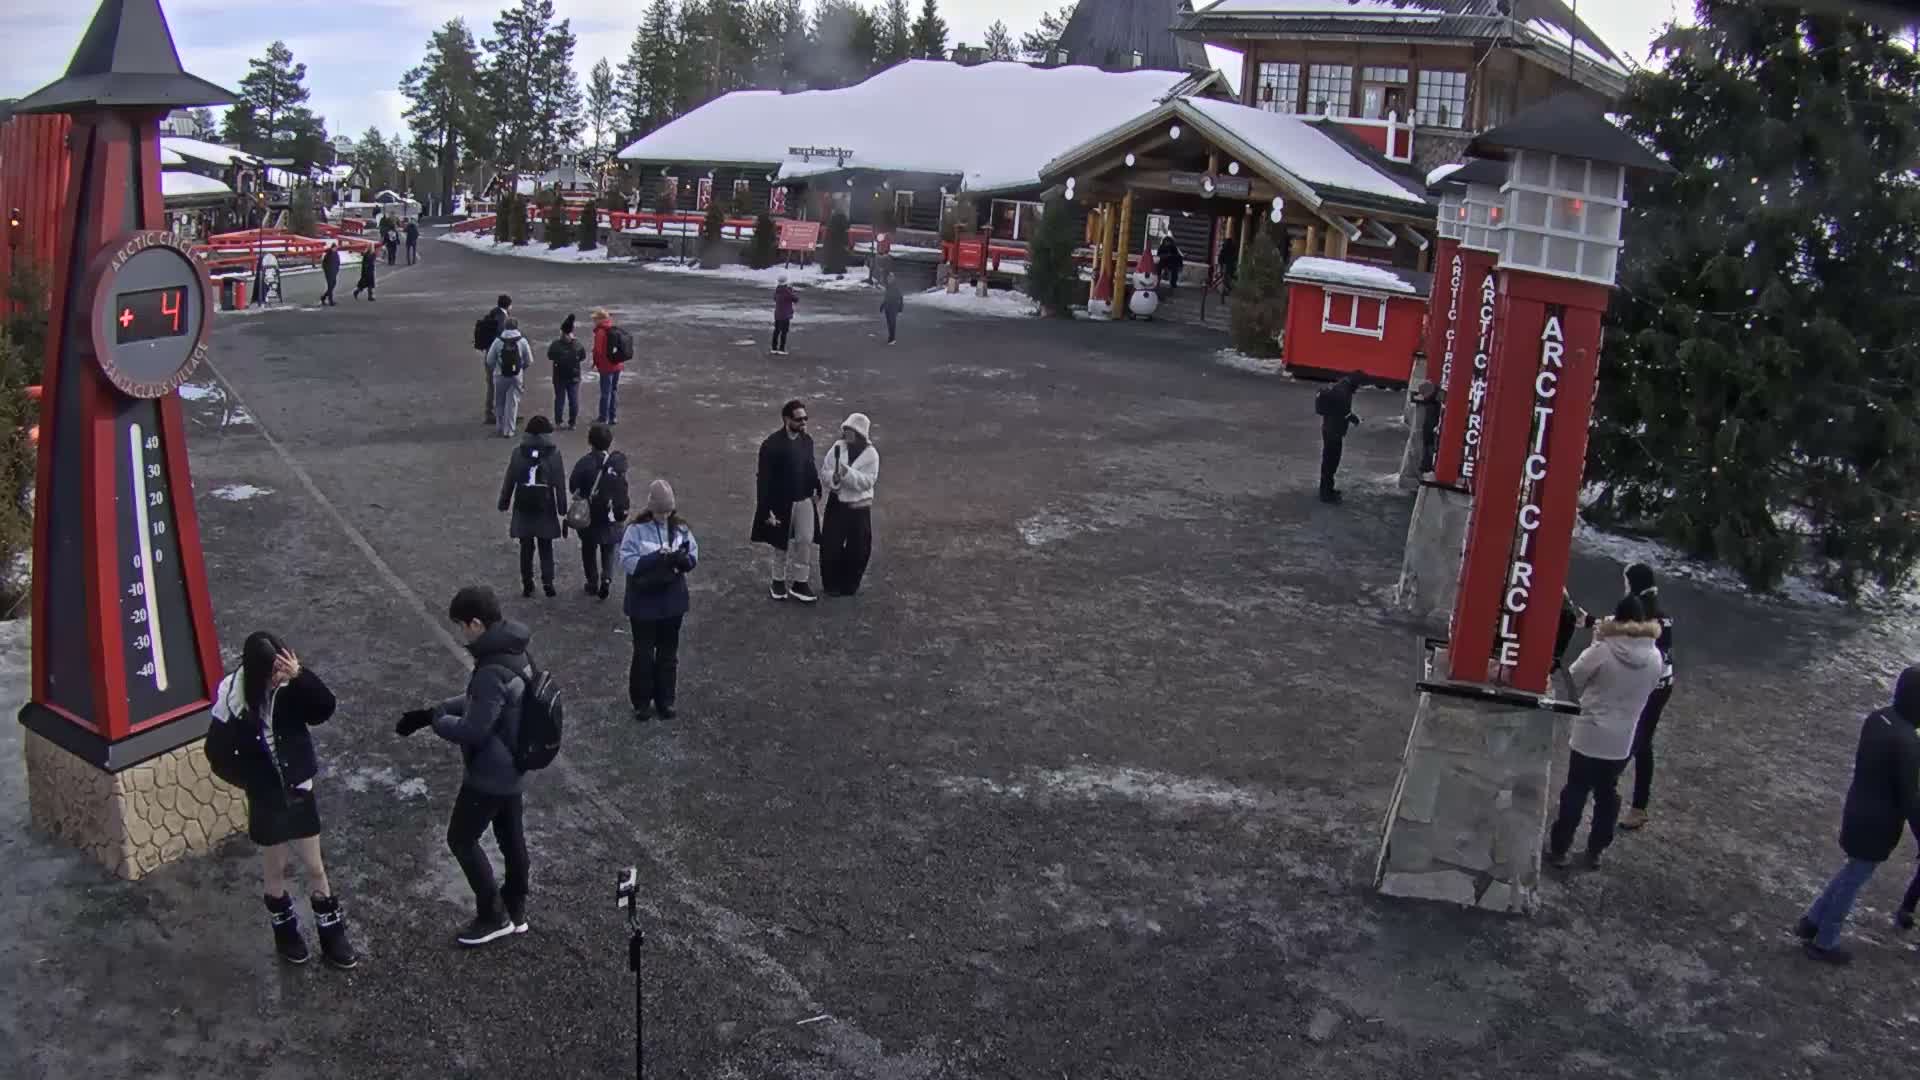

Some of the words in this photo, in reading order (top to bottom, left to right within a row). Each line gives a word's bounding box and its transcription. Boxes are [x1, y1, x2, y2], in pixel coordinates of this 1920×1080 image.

[111, 231, 154, 272] ARCTIC
[159, 231, 207, 265] CIRCLE
[1447, 254, 1462, 321] ARCTIC
[161, 290, 181, 331] 4
[1474, 274, 1495, 369] ARCTIC
[169, 342, 209, 388] VILLAGE
[1440, 329, 1455, 392] CIRCLE
[1525, 316, 1564, 481] ARCTIC
[1462, 379, 1488, 477] CIRCLE
[144, 435, 159, 450] 40
[147, 463, 161, 479] 30
[149, 491, 163, 507] 20
[153, 520, 165, 536] 10
[133, 554, 141, 568] 0
[155, 549, 163, 562] 0
[127, 582, 144, 596] -10
[1500, 504, 1541, 666] CIRCLE
[130, 608, 147, 623] -20
[133, 634, 150, 650] -30
[136, 662, 154, 677] -40
